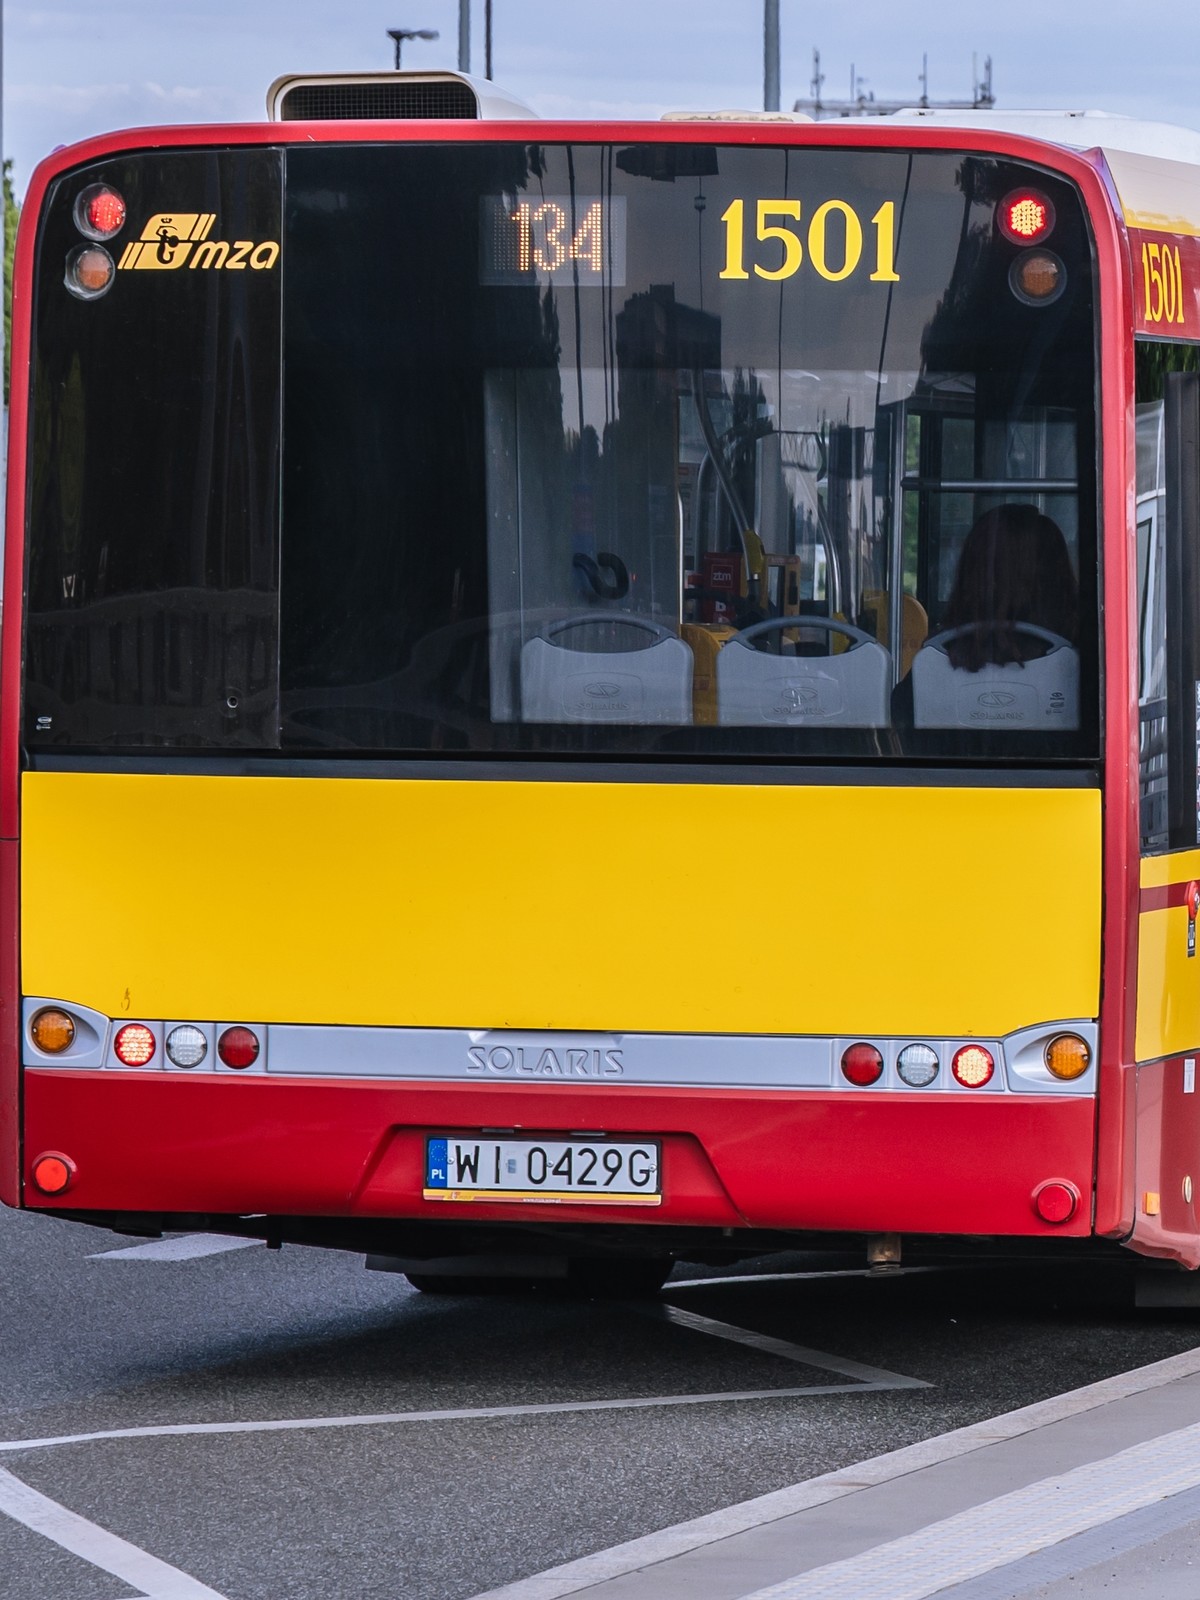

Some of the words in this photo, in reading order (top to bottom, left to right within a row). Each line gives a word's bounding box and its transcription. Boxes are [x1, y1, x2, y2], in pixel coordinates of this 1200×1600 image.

[510, 203, 602, 271] 134
[719, 199, 900, 281] 1501
[189, 241, 280, 270] mza
[1142, 242, 1185, 323] 1501
[712, 571, 731, 581] ztm
[969, 711, 1025, 720] SOLARIS
[466, 1046, 624, 1077] SOLARIS
[431, 1169, 445, 1180] PL
[455, 1145, 501, 1184] WI
[527, 1147, 652, 1187] 0429G
